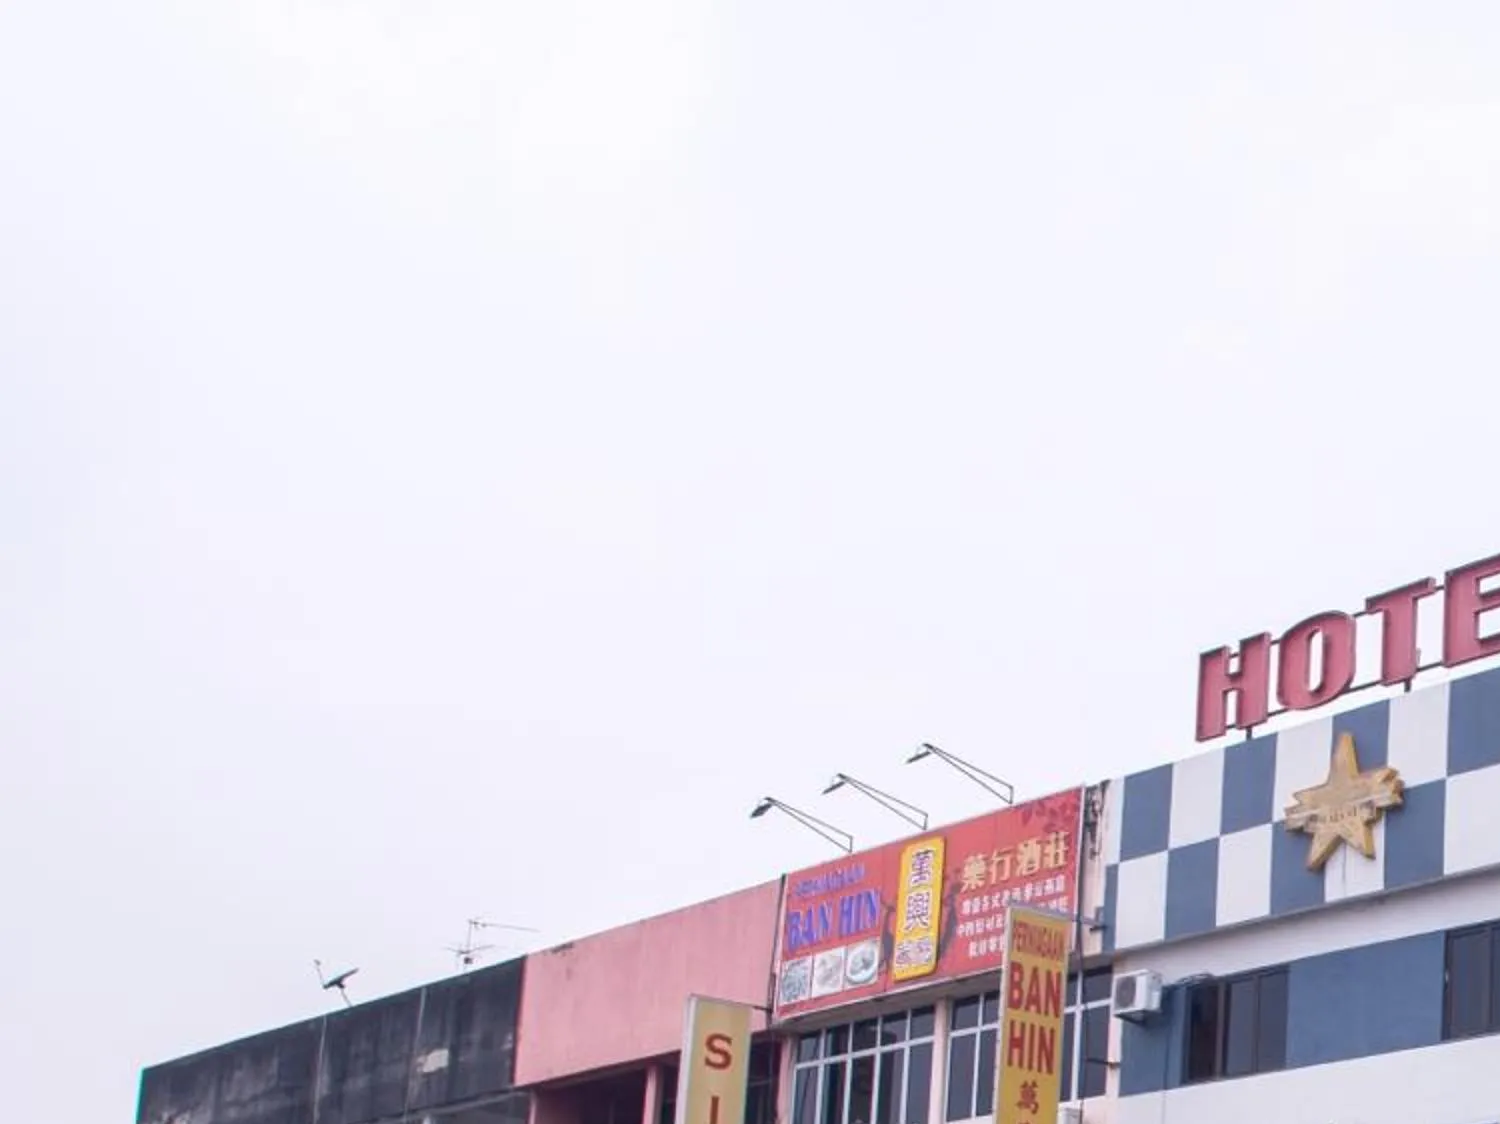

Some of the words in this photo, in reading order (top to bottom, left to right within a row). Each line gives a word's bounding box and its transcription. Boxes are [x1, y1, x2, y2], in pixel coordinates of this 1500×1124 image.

[788, 900, 832, 953] BAN
[839, 888, 881, 938] HIN
[1008, 960, 1062, 1019] BAN
[1007, 1019, 1055, 1075] HIN
